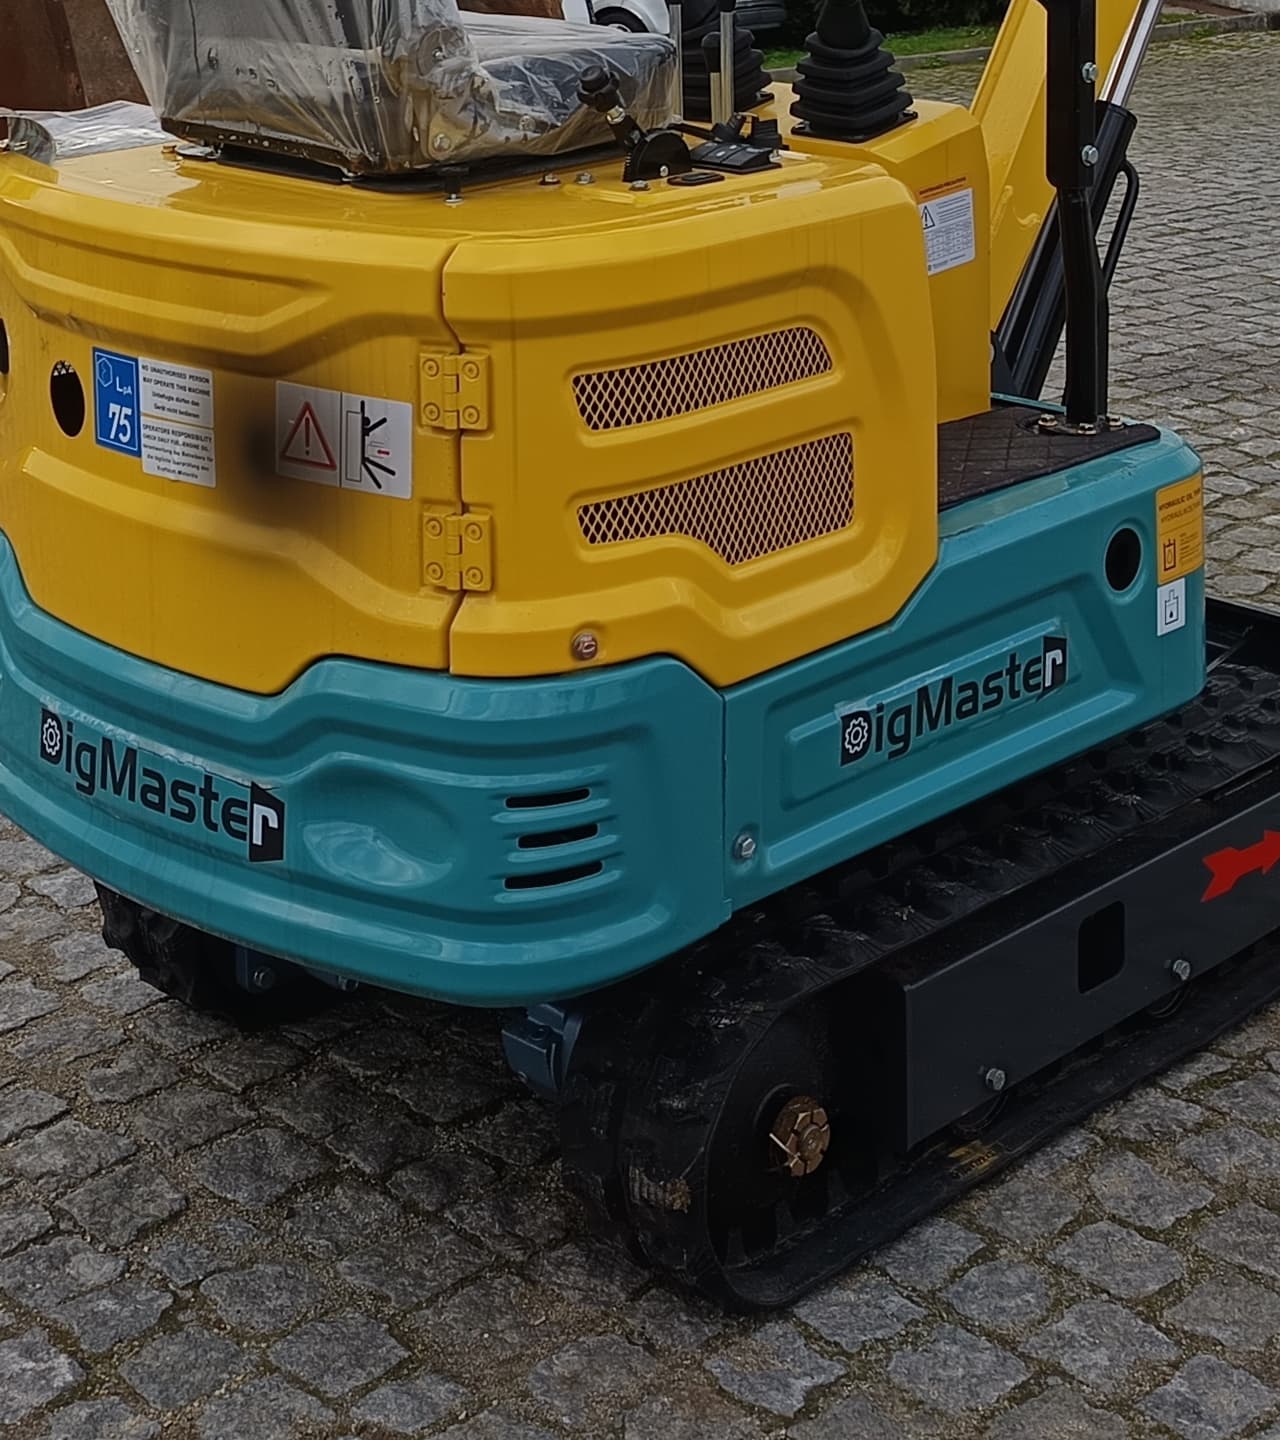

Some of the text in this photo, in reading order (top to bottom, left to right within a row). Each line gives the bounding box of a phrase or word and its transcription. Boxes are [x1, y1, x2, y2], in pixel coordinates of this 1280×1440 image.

[188, 374, 210, 384] PERSON
[108, 402, 132, 443] 75
[840, 635, 1067, 767] DigMaster
[40, 707, 285, 861] DigMaster
